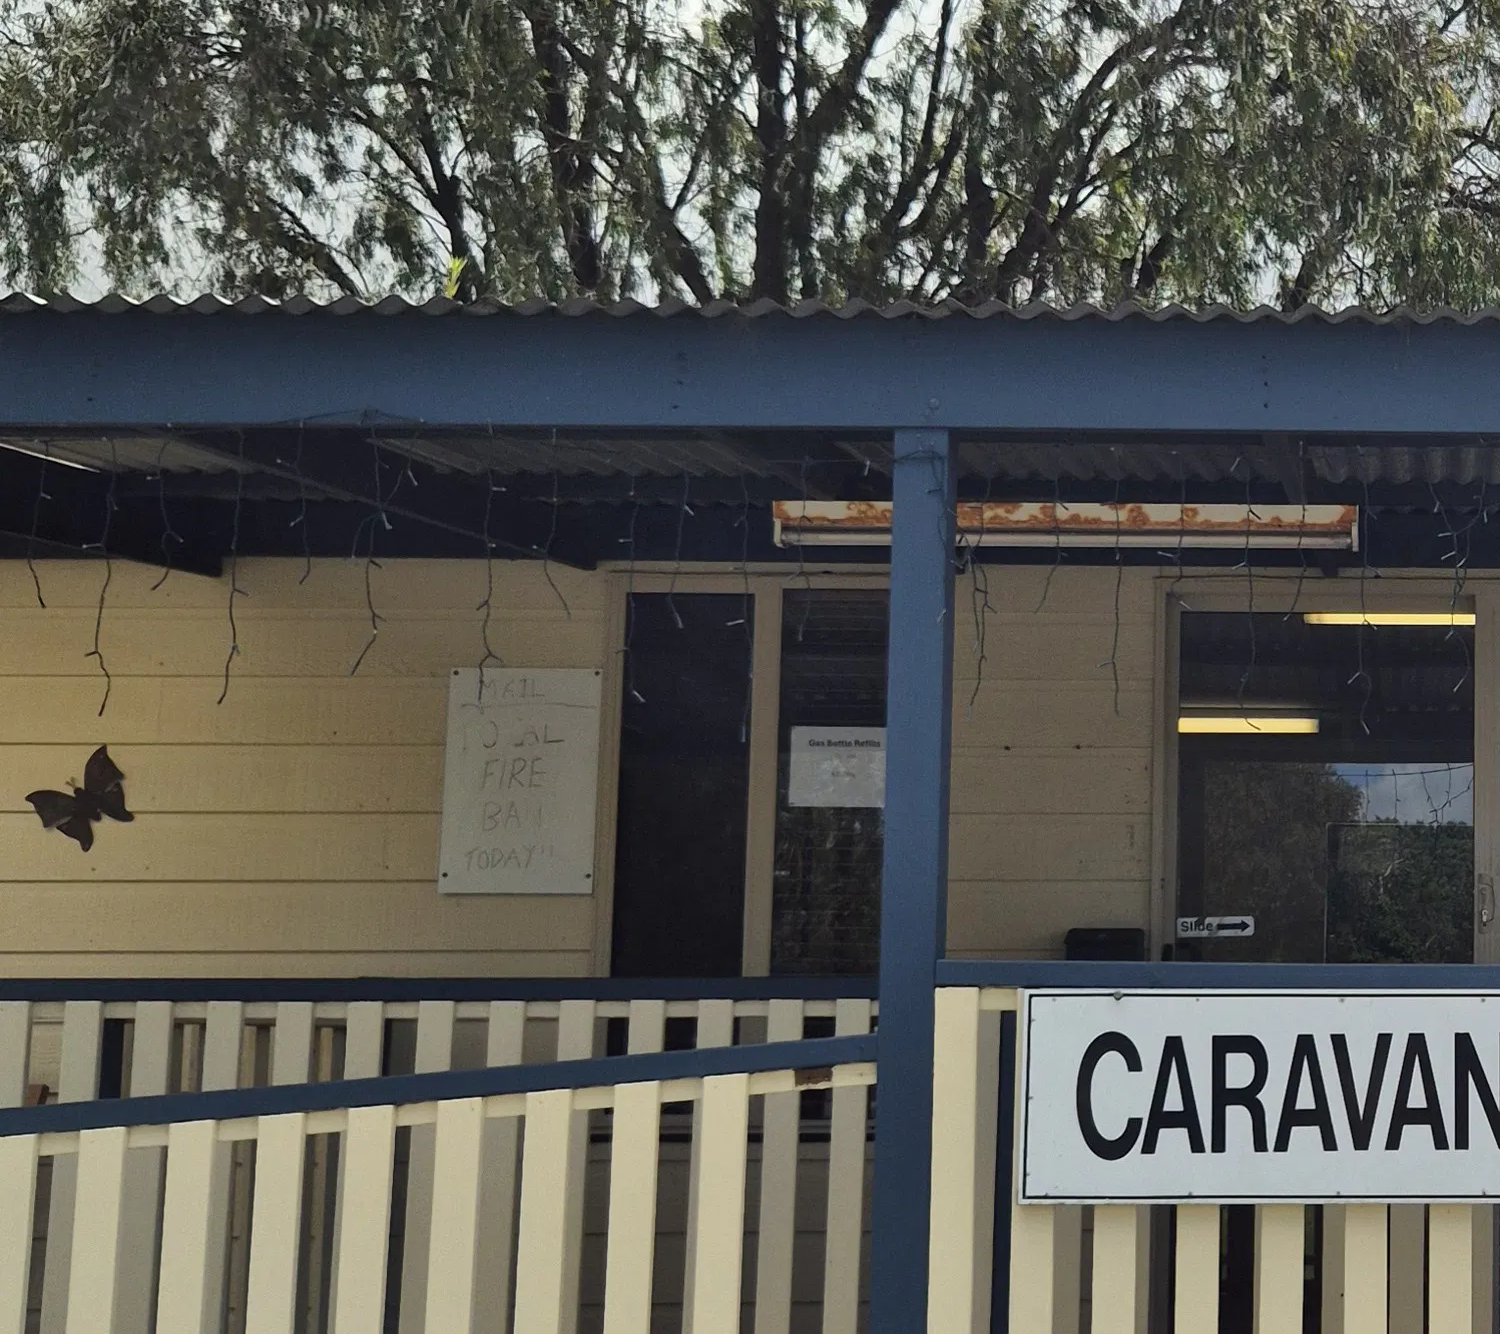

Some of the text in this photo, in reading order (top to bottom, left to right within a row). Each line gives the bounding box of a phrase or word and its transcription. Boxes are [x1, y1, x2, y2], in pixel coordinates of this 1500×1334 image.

[809, 738, 825, 747] Gas
[827, 739, 853, 747] Bottle
[480, 757, 547, 789] FIRE
[1180, 920, 1213, 932] Slide
